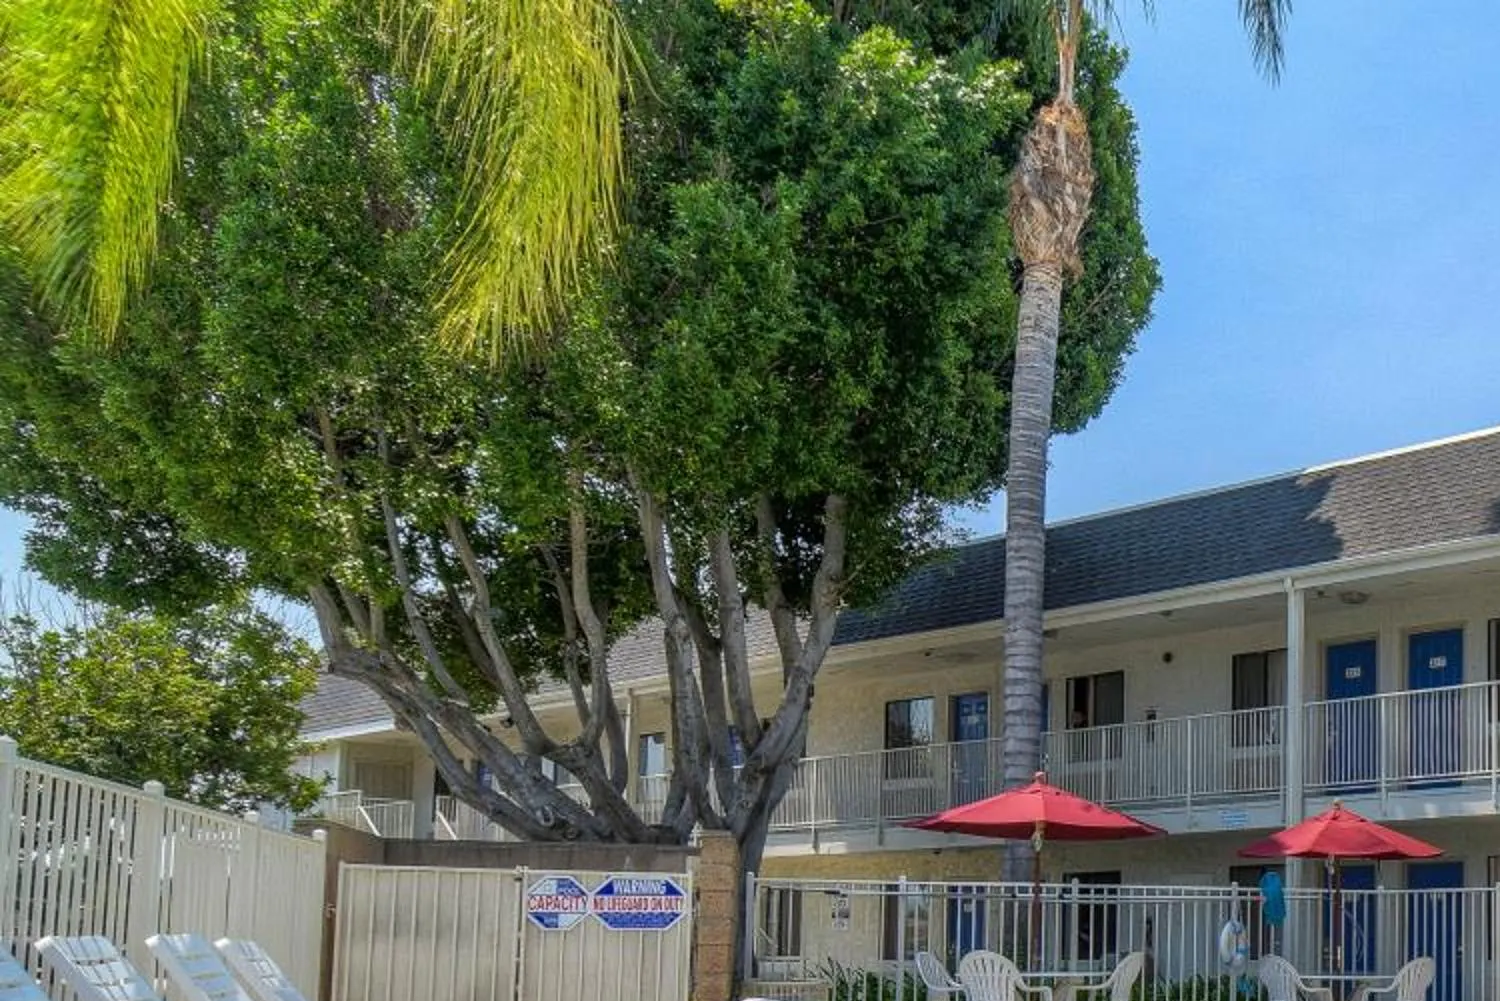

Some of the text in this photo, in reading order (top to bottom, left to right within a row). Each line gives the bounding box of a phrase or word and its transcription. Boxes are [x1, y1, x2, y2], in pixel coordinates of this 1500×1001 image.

[613, 879, 667, 895] WARNING
[528, 896, 587, 911] CAPACITY
[593, 897, 683, 911] NO LIFEGUARD ON DUTY
